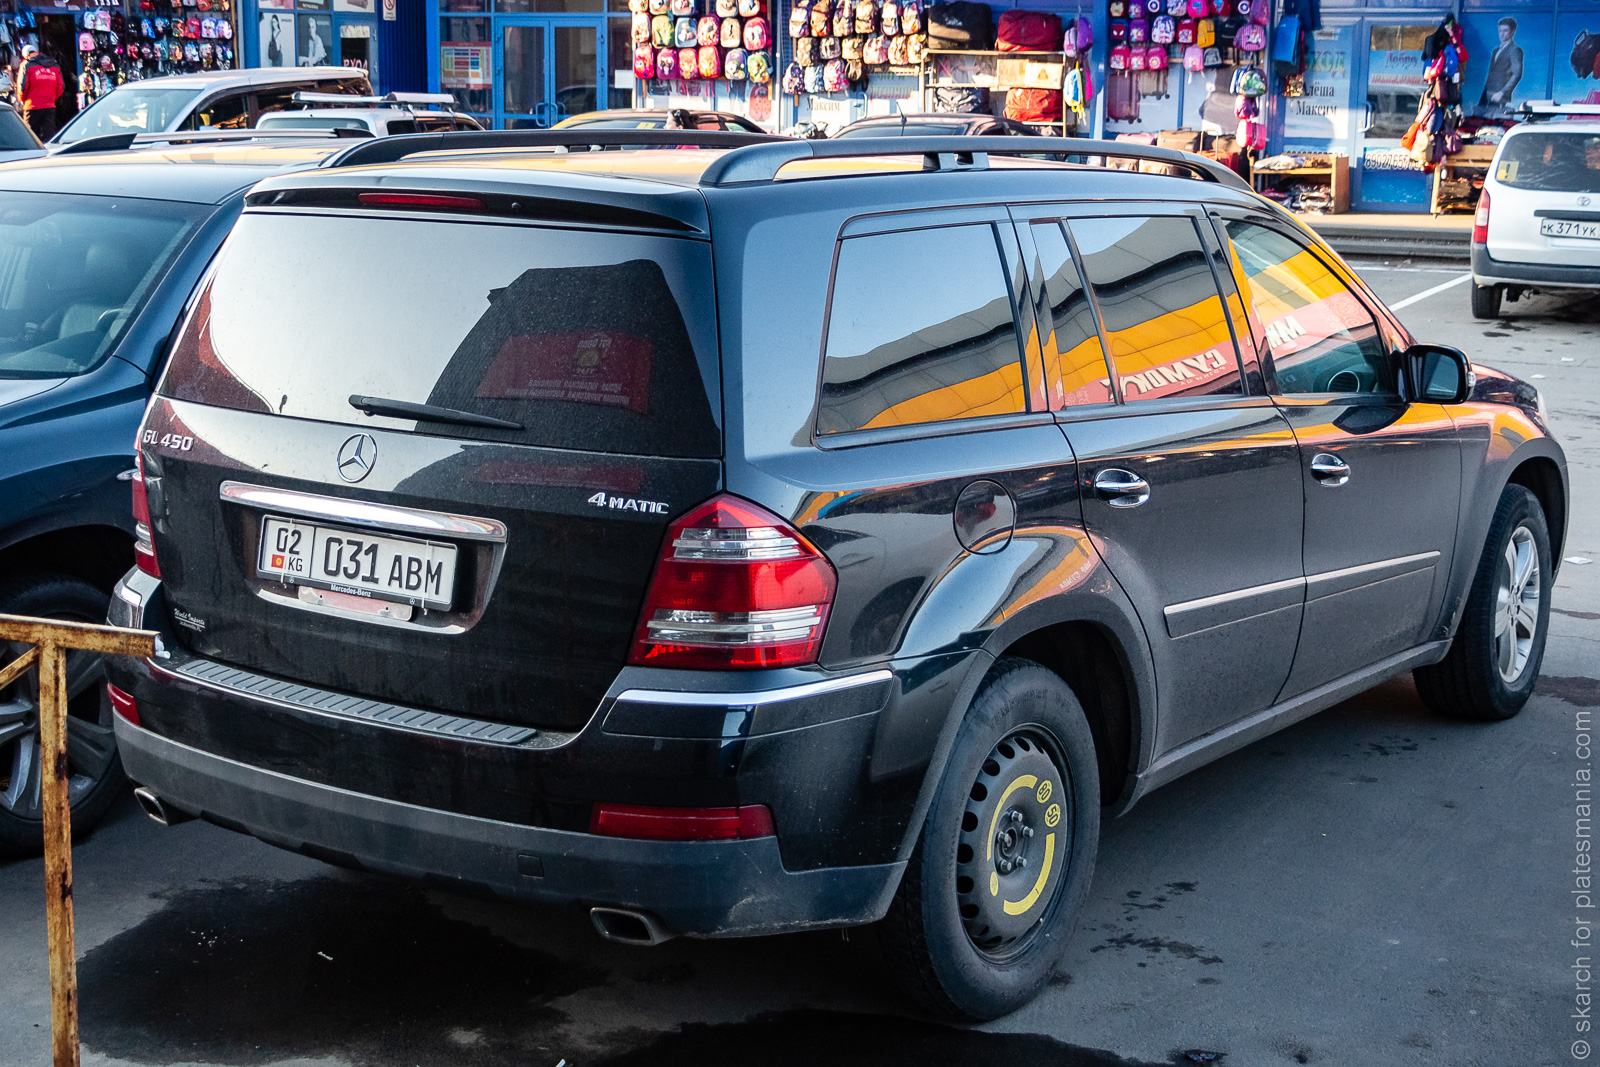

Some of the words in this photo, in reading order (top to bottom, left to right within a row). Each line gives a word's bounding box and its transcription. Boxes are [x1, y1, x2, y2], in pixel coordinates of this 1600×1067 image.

[806, 97, 840, 112] Максим
[1296, 100, 1337, 116] Максим
[143, 429, 159, 445] GL
[160, 433, 194, 451] 450
[276, 527, 302, 555] 02
[288, 557, 303, 572] KG
[323, 536, 379, 584] 031
[388, 554, 443, 595] ABM
[330, 583, 372, 597] Mercedes-Benz
[1038, 782, 1051, 801] 80
[1046, 805, 1059, 825] 50
